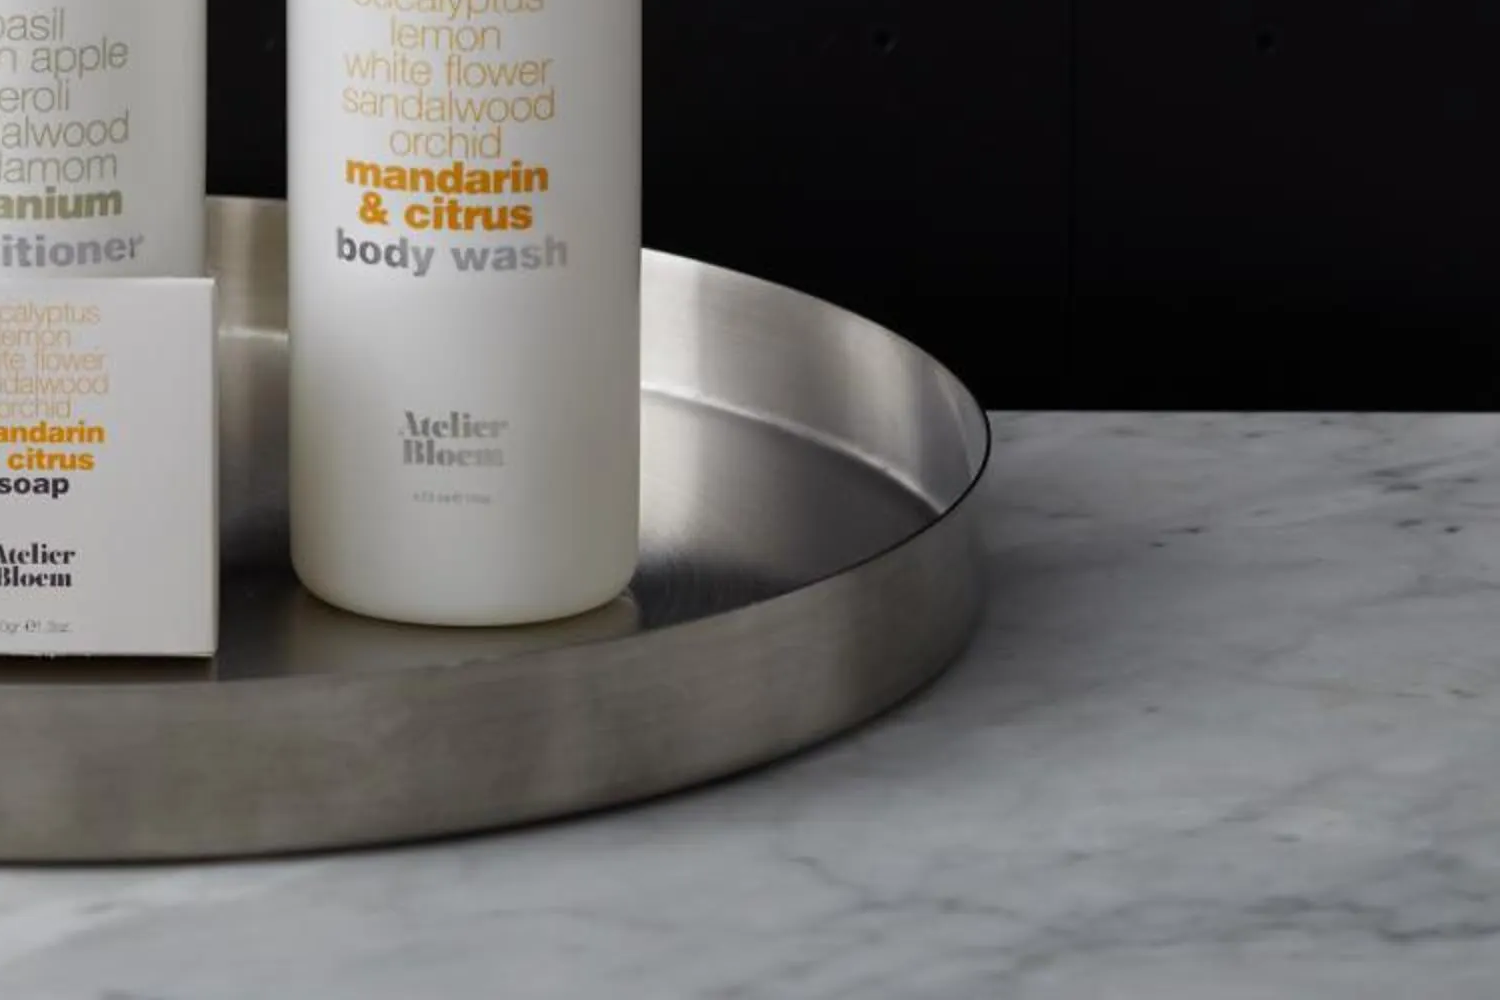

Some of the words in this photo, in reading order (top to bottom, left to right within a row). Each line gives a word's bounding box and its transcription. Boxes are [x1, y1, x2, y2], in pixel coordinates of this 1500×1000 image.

[389, 15, 502, 52] lemon
[30, 36, 130, 79] apple
[344, 50, 433, 86] white
[446, 53, 554, 88] flower
[342, 86, 556, 124] sandalwood
[388, 127, 502, 160] orchid
[344, 158, 550, 195] mandarin
[358, 191, 388, 225] &
[404, 197, 534, 231] citrus
[336, 227, 435, 277] body
[450, 235, 569, 273] wash
[34, 351, 106, 371] flower
[398, 410, 509, 438] Atelier
[7, 447, 96, 471] citrus
[403, 439, 505, 467] Bloem
